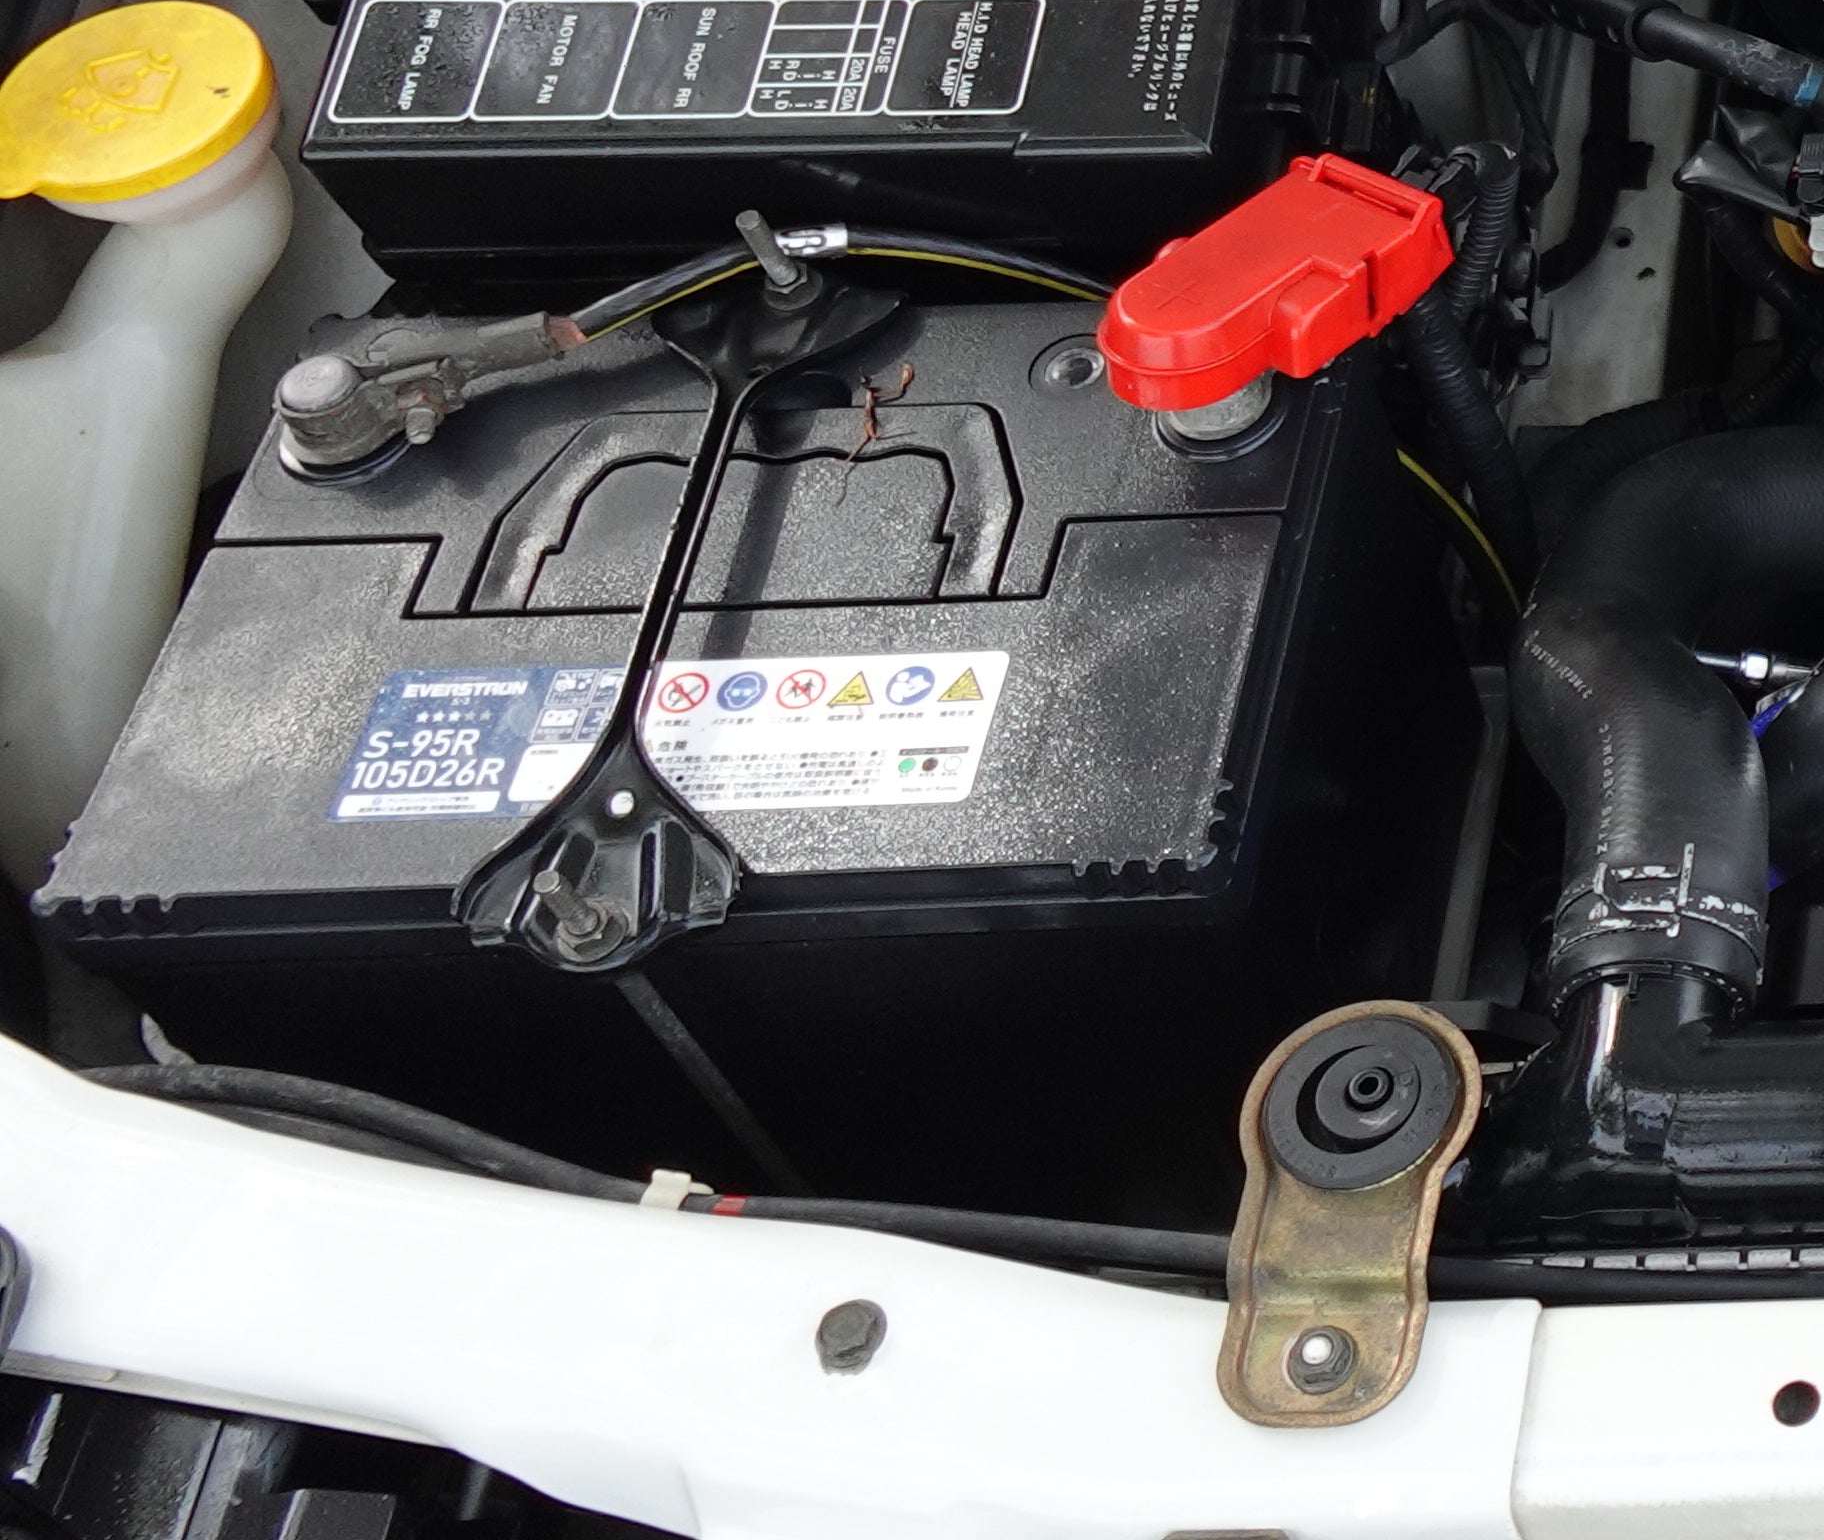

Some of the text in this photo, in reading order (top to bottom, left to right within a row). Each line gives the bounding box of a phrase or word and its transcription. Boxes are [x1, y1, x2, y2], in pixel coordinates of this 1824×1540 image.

[400, 8, 442, 111] RR FOG LAMP
[536, 15, 578, 104] MOTOR FAN
[673, 7, 717, 109] SUN ROOF RR
[849, 58, 866, 82] 20A
[874, 36, 896, 75] FUSE
[940, 10, 973, 97] HEAD LAMP
[956, 2, 993, 109] H.I.D HEAD LAMP
[840, 87, 857, 111] 20A
[362, 728, 481, 759] S-95R
[657, 739, 688, 752] 危険
[351, 757, 506, 790] 105D26R
